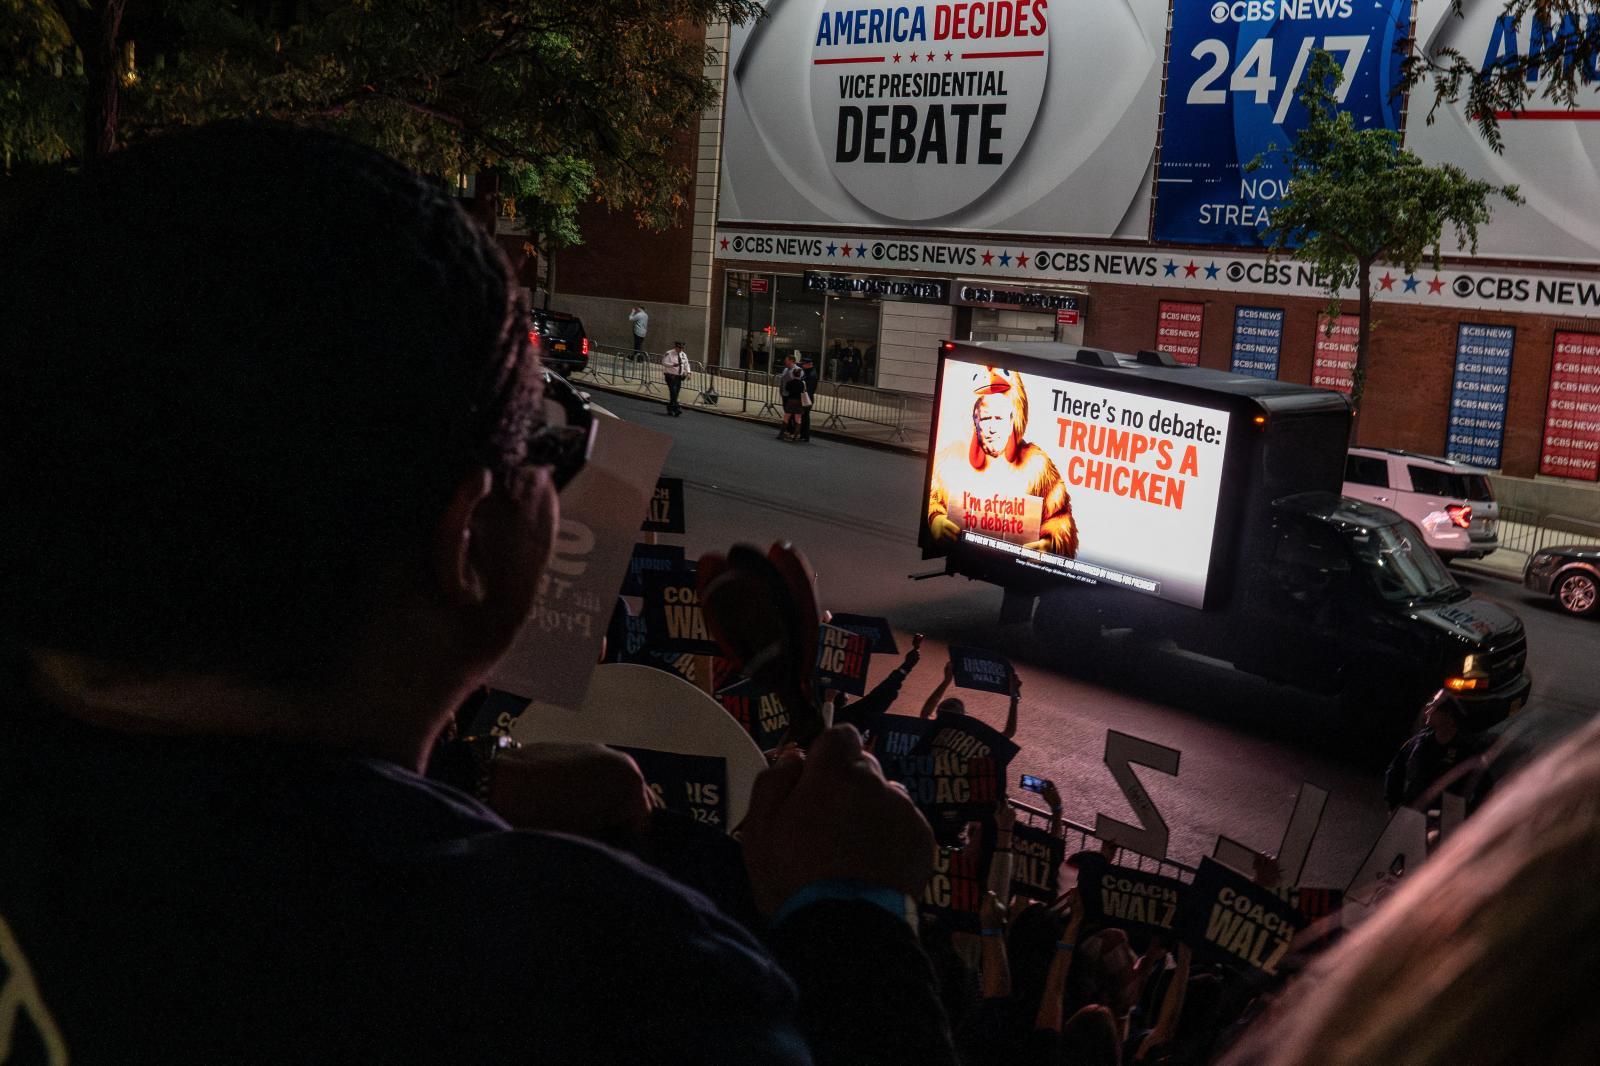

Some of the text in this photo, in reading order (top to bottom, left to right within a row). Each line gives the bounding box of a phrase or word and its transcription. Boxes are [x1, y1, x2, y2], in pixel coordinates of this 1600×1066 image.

[1230, 0, 1353, 22] CBS NEWS
[816, 0, 1048, 46] AMERICA DECIDES
[839, 71, 1007, 98] VICE PRESIDENTIAL
[1186, 35, 1370, 124] 24/7
[835, 104, 1007, 164] DEBATE
[1199, 204, 1273, 227] STREA
[745, 237, 822, 257] CBS NEWS
[886, 242, 976, 266] CBS NEWS
[1052, 253, 1157, 277] CBS NEWS
[1247, 263, 1291, 285] CBS
[1476, 277, 1529, 301] CBS
[1180, 313, 1200, 321] NEWS
[1244, 310, 1281, 320] CBS NEWS
[1165, 328, 1199, 338] CBS NEWS
[1243, 327, 1279, 337] CBS NEWS
[1341, 326, 1359, 335] NEW
[1469, 327, 1512, 338] CBS NEWS
[1177, 346, 1198, 354] NEWS
[1255, 344, 1277, 354] NEWS
[1323, 343, 1359, 352] CBS NEW
[1467, 346, 1510, 357] CBS NEWS
[1565, 344, 1581, 354] CBS
[1240, 360, 1275, 370] CBS NEWS
[1322, 360, 1357, 370] CBS NEW
[1465, 364, 1507, 375] CBS NEWS
[1563, 363, 1579, 372] CBS
[1320, 377, 1354, 387] CBS NEW
[1463, 382, 1505, 393] CBS NEWS
[1560, 382, 1577, 391] CBS
[1461, 400, 1503, 411] CBS NEWS
[1558, 400, 1575, 410] CBS
[1052, 389, 1221, 445] There's no debate:
[1459, 418, 1501, 429] CBS NEWS
[1556, 419, 1573, 429] CBS
[1057, 417, 1198, 477] TRUMP'S A
[1457, 435, 1499, 448] CBS NEWS
[1554, 437, 1599, 451] CBS NEWS
[1472, 454, 1497, 466] NEWS
[1551, 455, 1596, 469] CBS NEWS
[1068, 456, 1185, 510] CHICKEN
[963, 492, 1025, 516] I'm afraid
[964, 512, 1024, 534] to debate
[1101, 874, 1179, 905] COACH
[1101, 888, 1177, 929] WALZ
[1218, 885, 1297, 942] COACH
[1204, 901, 1293, 976] WALZ
